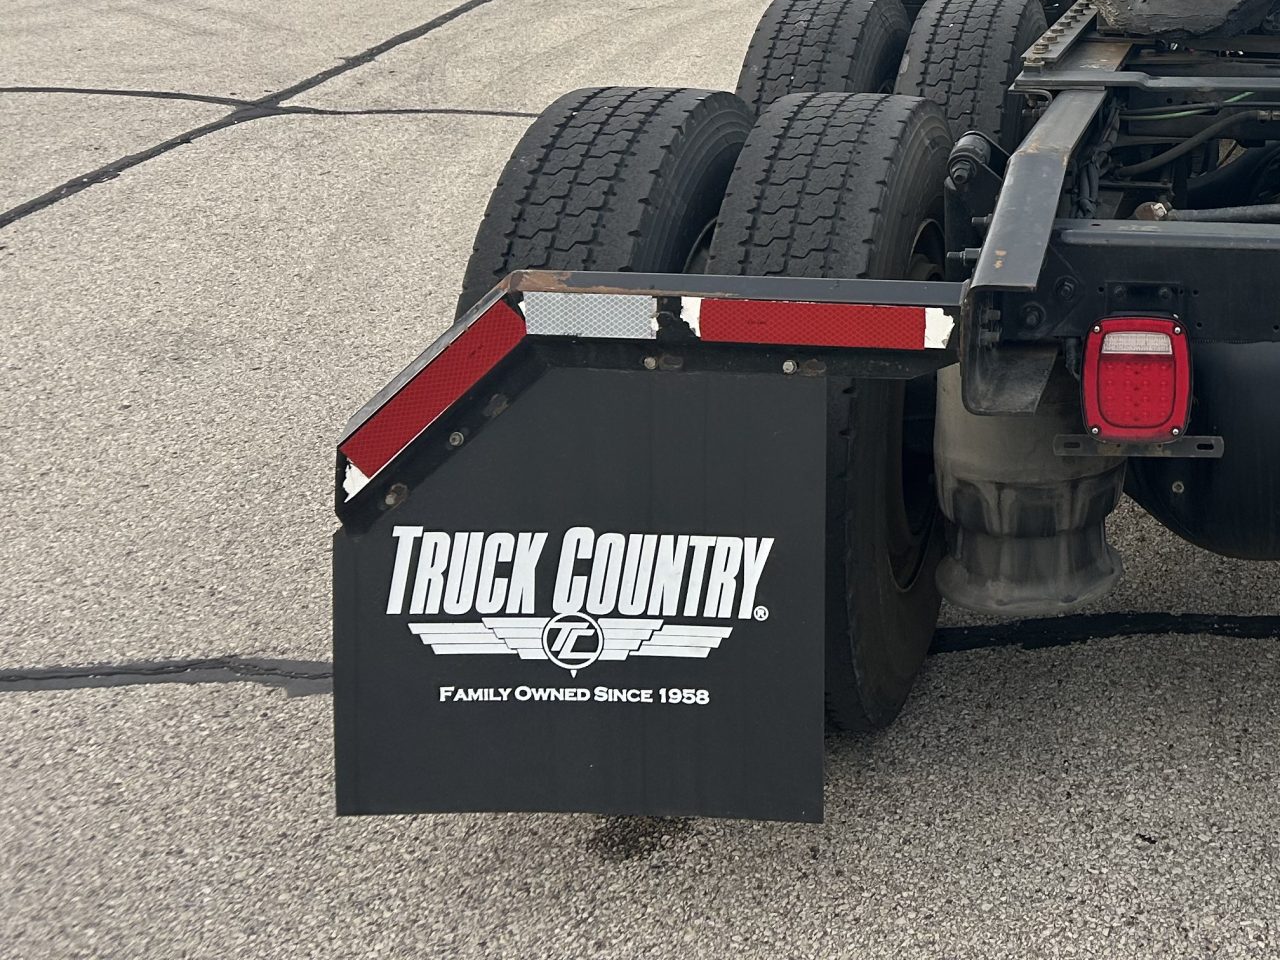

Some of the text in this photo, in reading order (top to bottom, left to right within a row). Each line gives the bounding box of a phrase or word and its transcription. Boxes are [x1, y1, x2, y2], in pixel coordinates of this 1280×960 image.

[386, 525, 549, 615] TRUCK
[438, 685, 710, 706] FAMILY OWNED SINCE 1958
